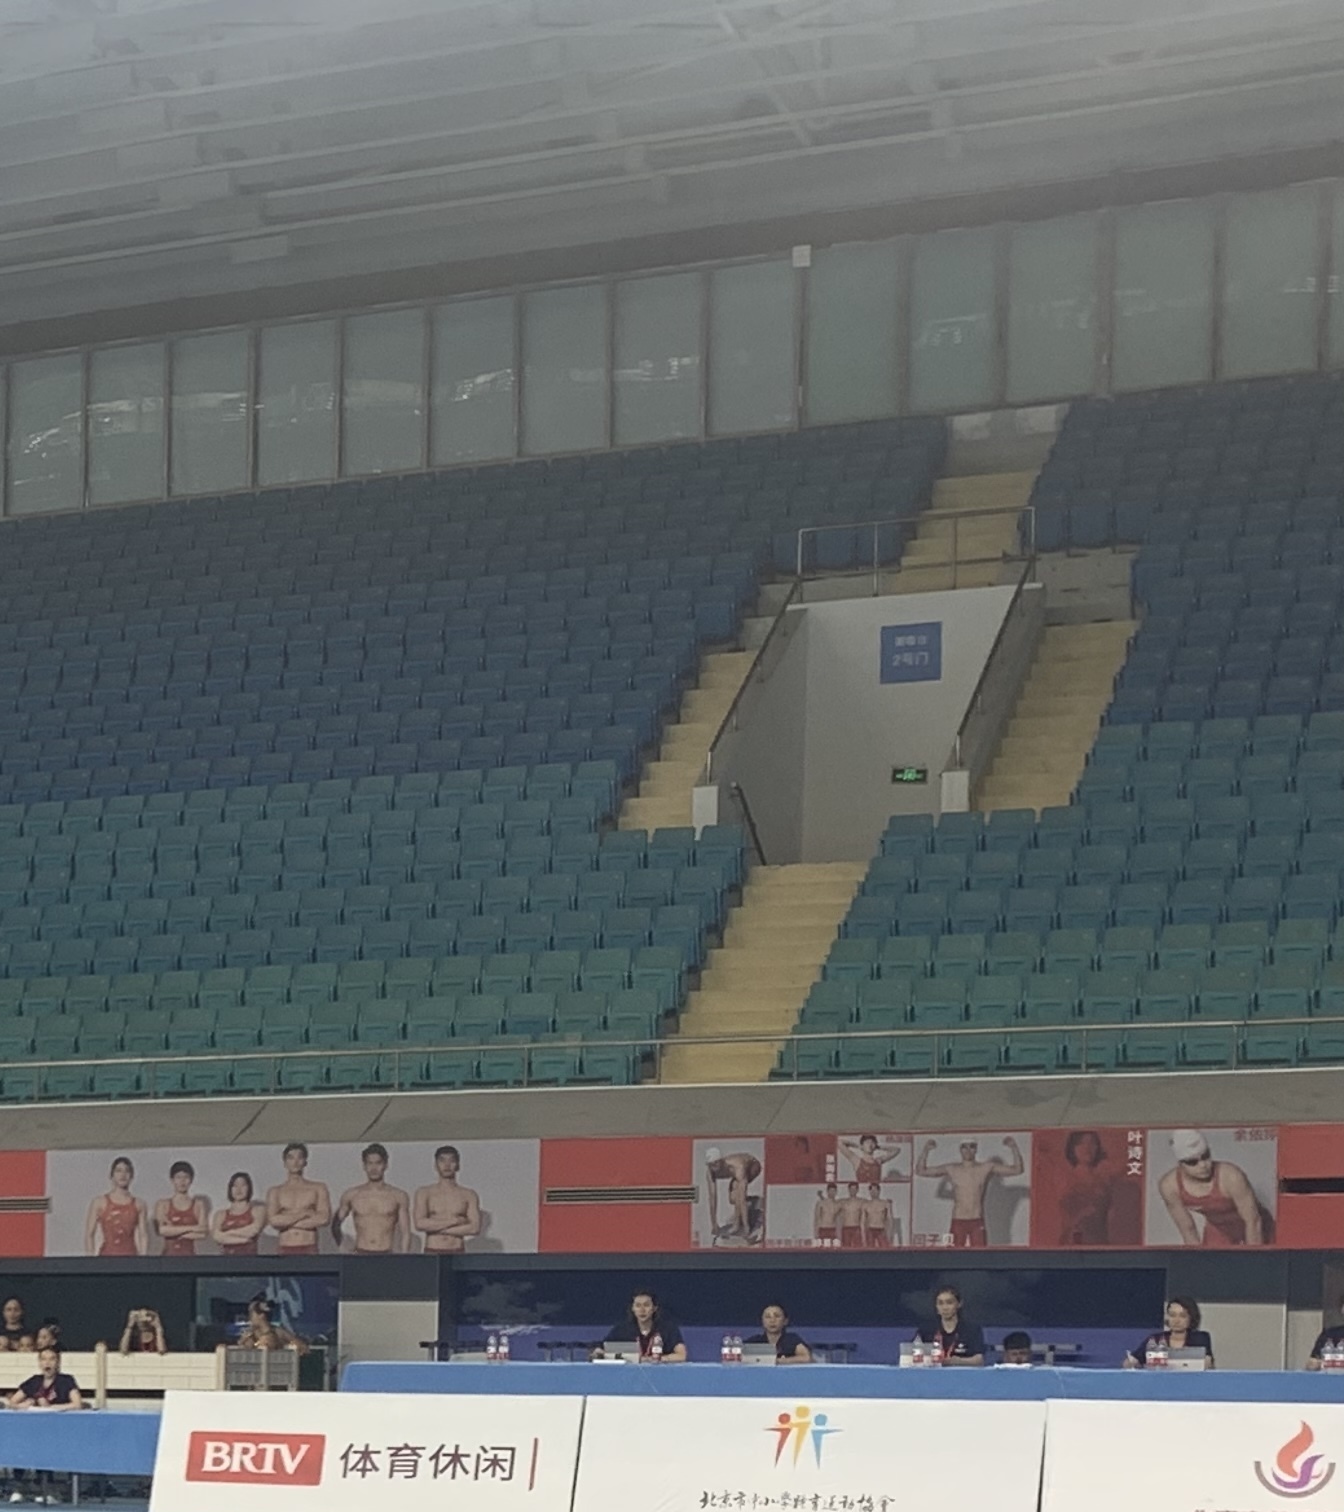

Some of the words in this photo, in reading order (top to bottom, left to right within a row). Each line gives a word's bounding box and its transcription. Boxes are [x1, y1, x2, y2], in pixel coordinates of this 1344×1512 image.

[201, 1440, 310, 1475] BRTV
[339, 1443, 517, 1481] 体育休闲
